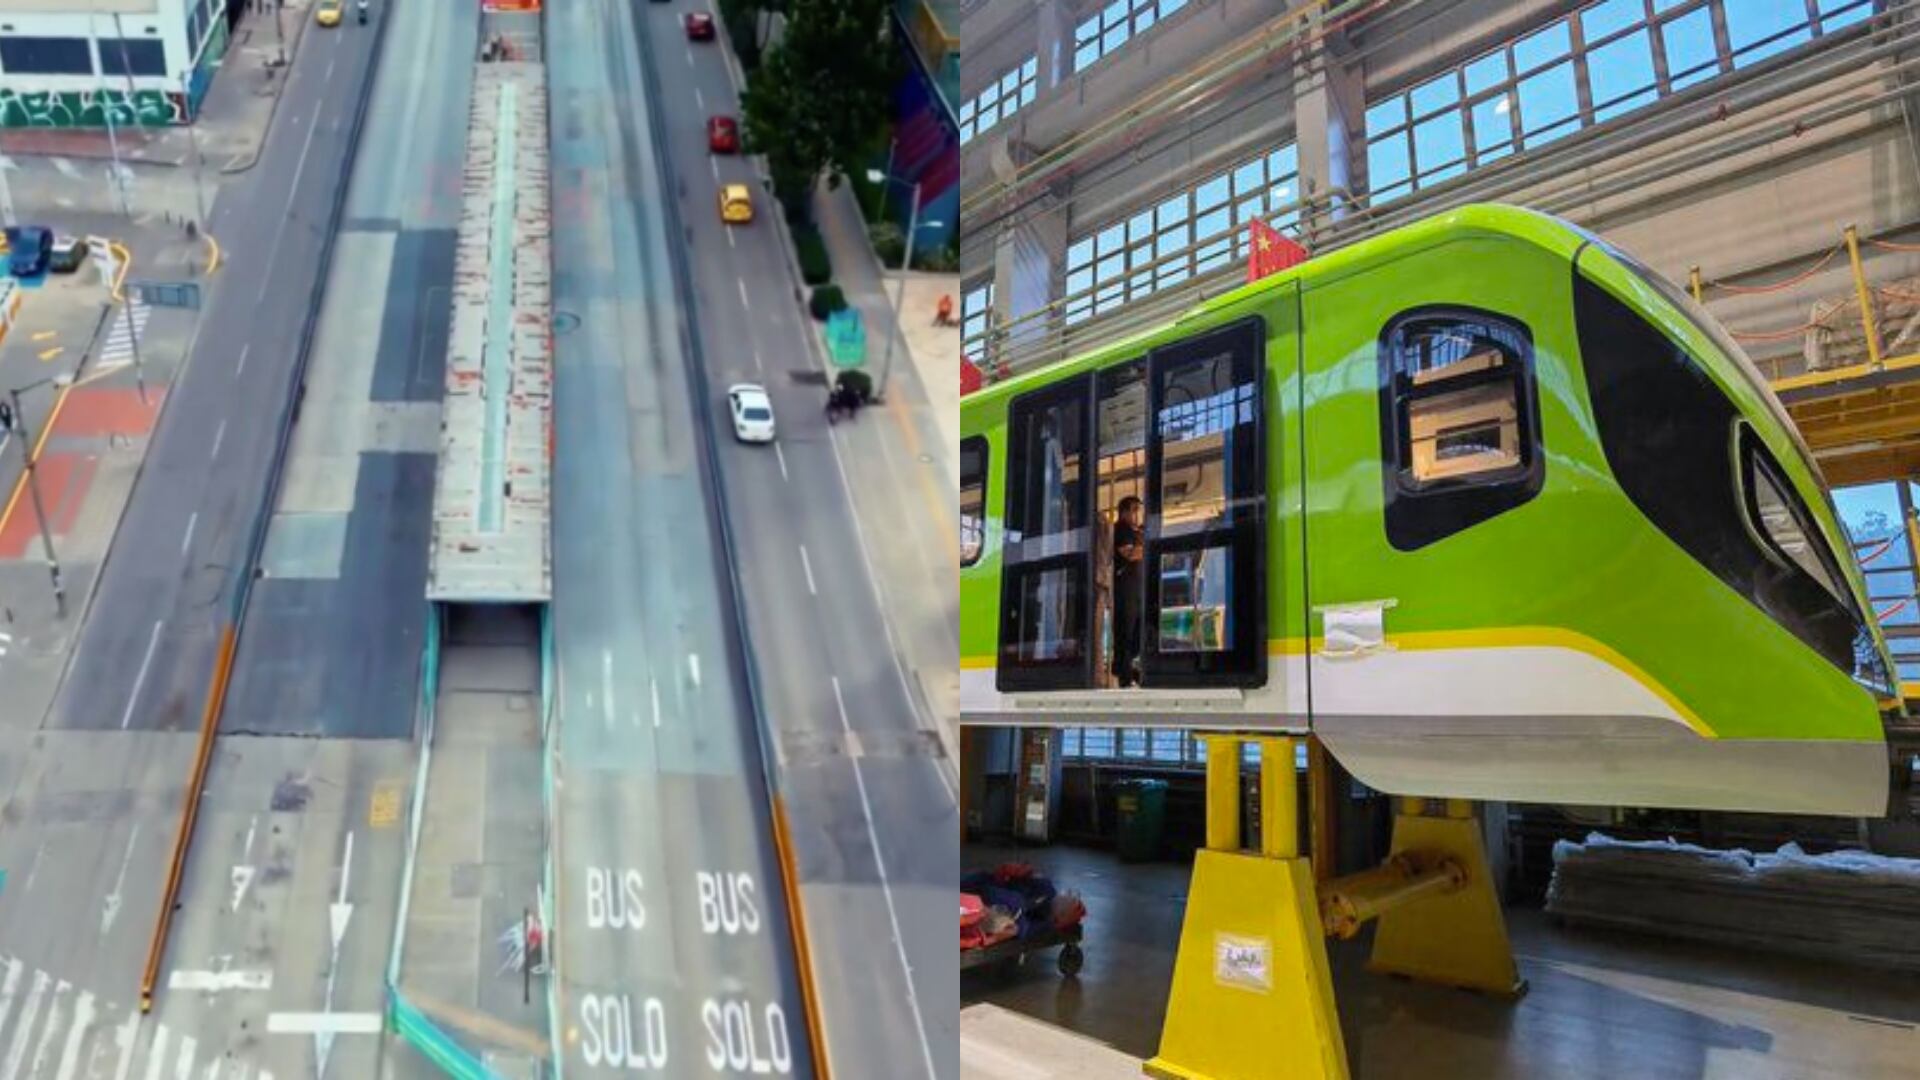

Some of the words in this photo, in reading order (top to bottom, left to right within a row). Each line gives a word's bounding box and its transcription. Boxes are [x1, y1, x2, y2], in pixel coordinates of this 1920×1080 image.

[587, 866, 646, 930] BUS
[696, 870, 760, 934] BUS
[581, 993, 667, 1069] SOLO
[701, 998, 791, 1074] SOLO
